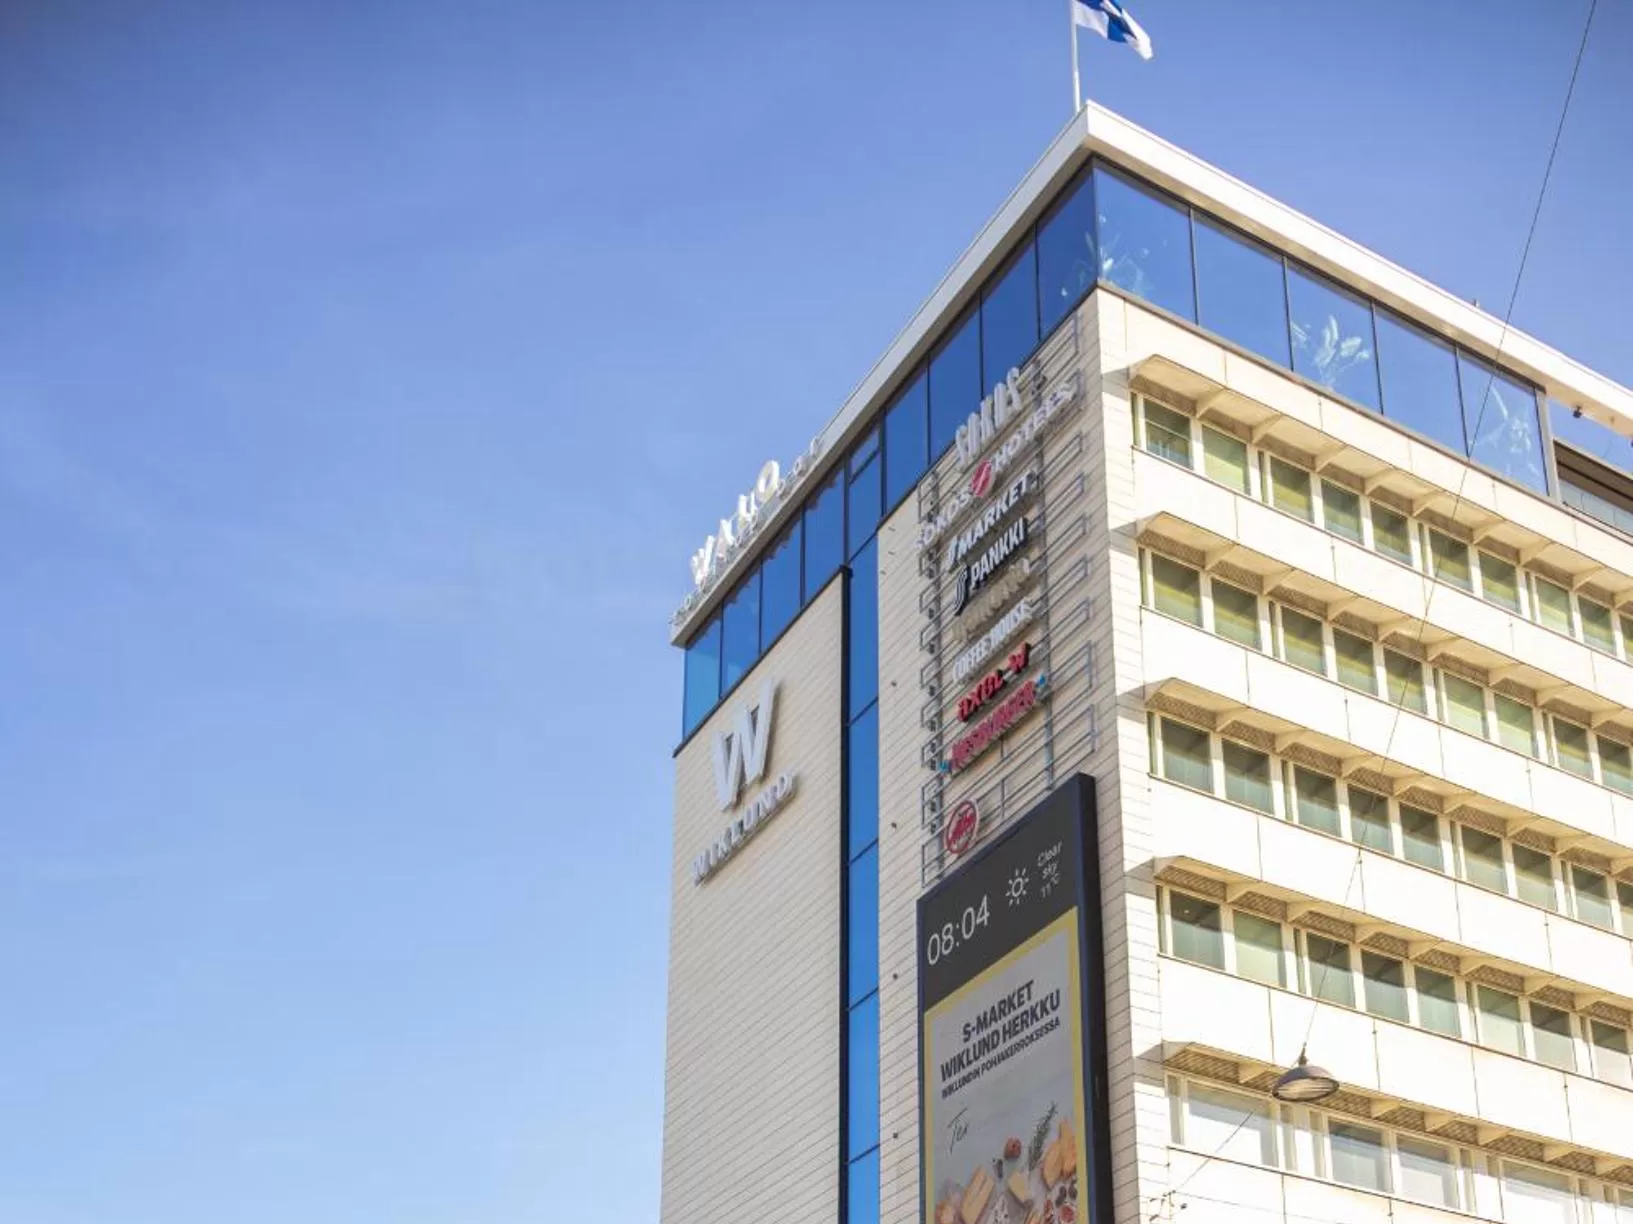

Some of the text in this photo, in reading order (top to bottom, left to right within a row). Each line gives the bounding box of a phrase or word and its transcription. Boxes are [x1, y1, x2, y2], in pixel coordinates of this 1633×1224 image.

[958, 471, 1033, 553] MARKET
[969, 517, 1028, 589] PANKKI
[713, 676, 774, 812] W
[691, 767, 797, 888] WIKLUND
[1037, 841, 1062, 867] Clear
[927, 895, 990, 965] 08:04
[940, 989, 1060, 1082] WIKLUND HERKKU
[963, 980, 1034, 1043] S-MARKET
